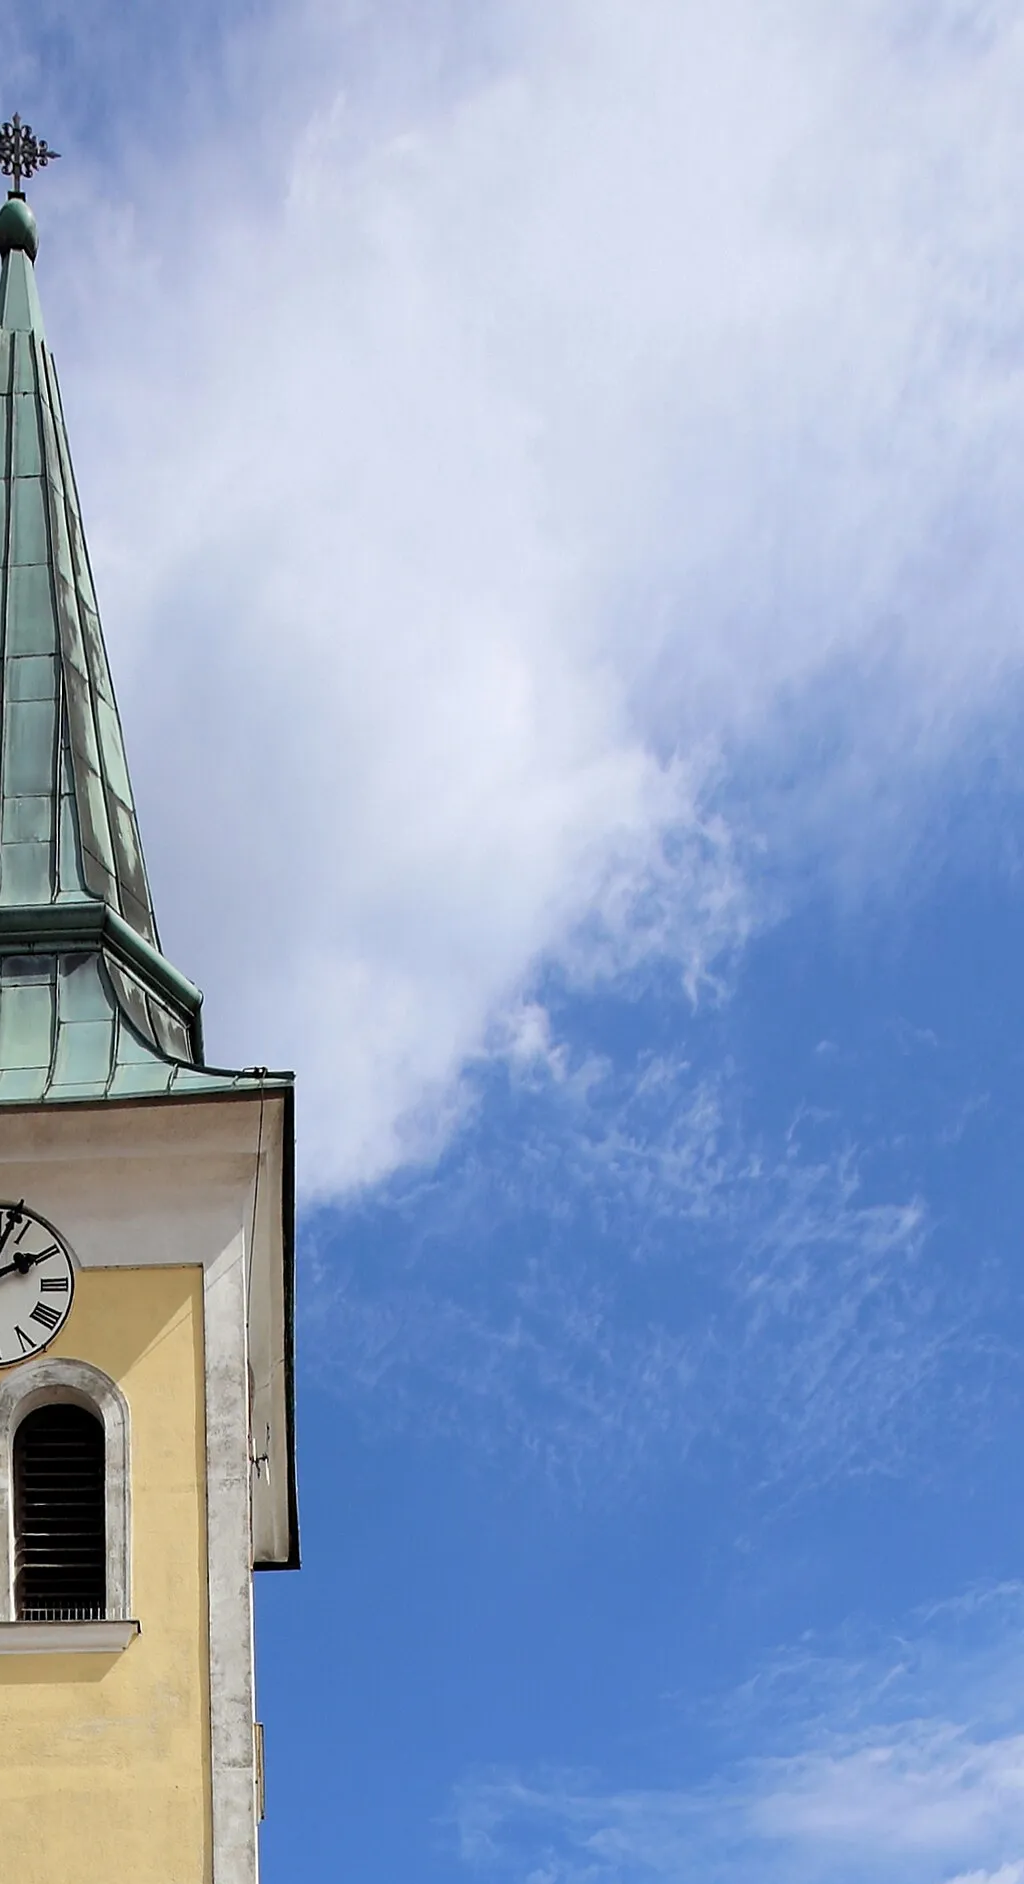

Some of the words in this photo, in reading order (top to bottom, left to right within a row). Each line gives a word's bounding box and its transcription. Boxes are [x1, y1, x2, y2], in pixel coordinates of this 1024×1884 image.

[14, 1220, 32, 1245] I
[40, 1278, 68, 1292] III
[30, 1301, 63, 1330] IIII
[14, 1325, 36, 1353] V
